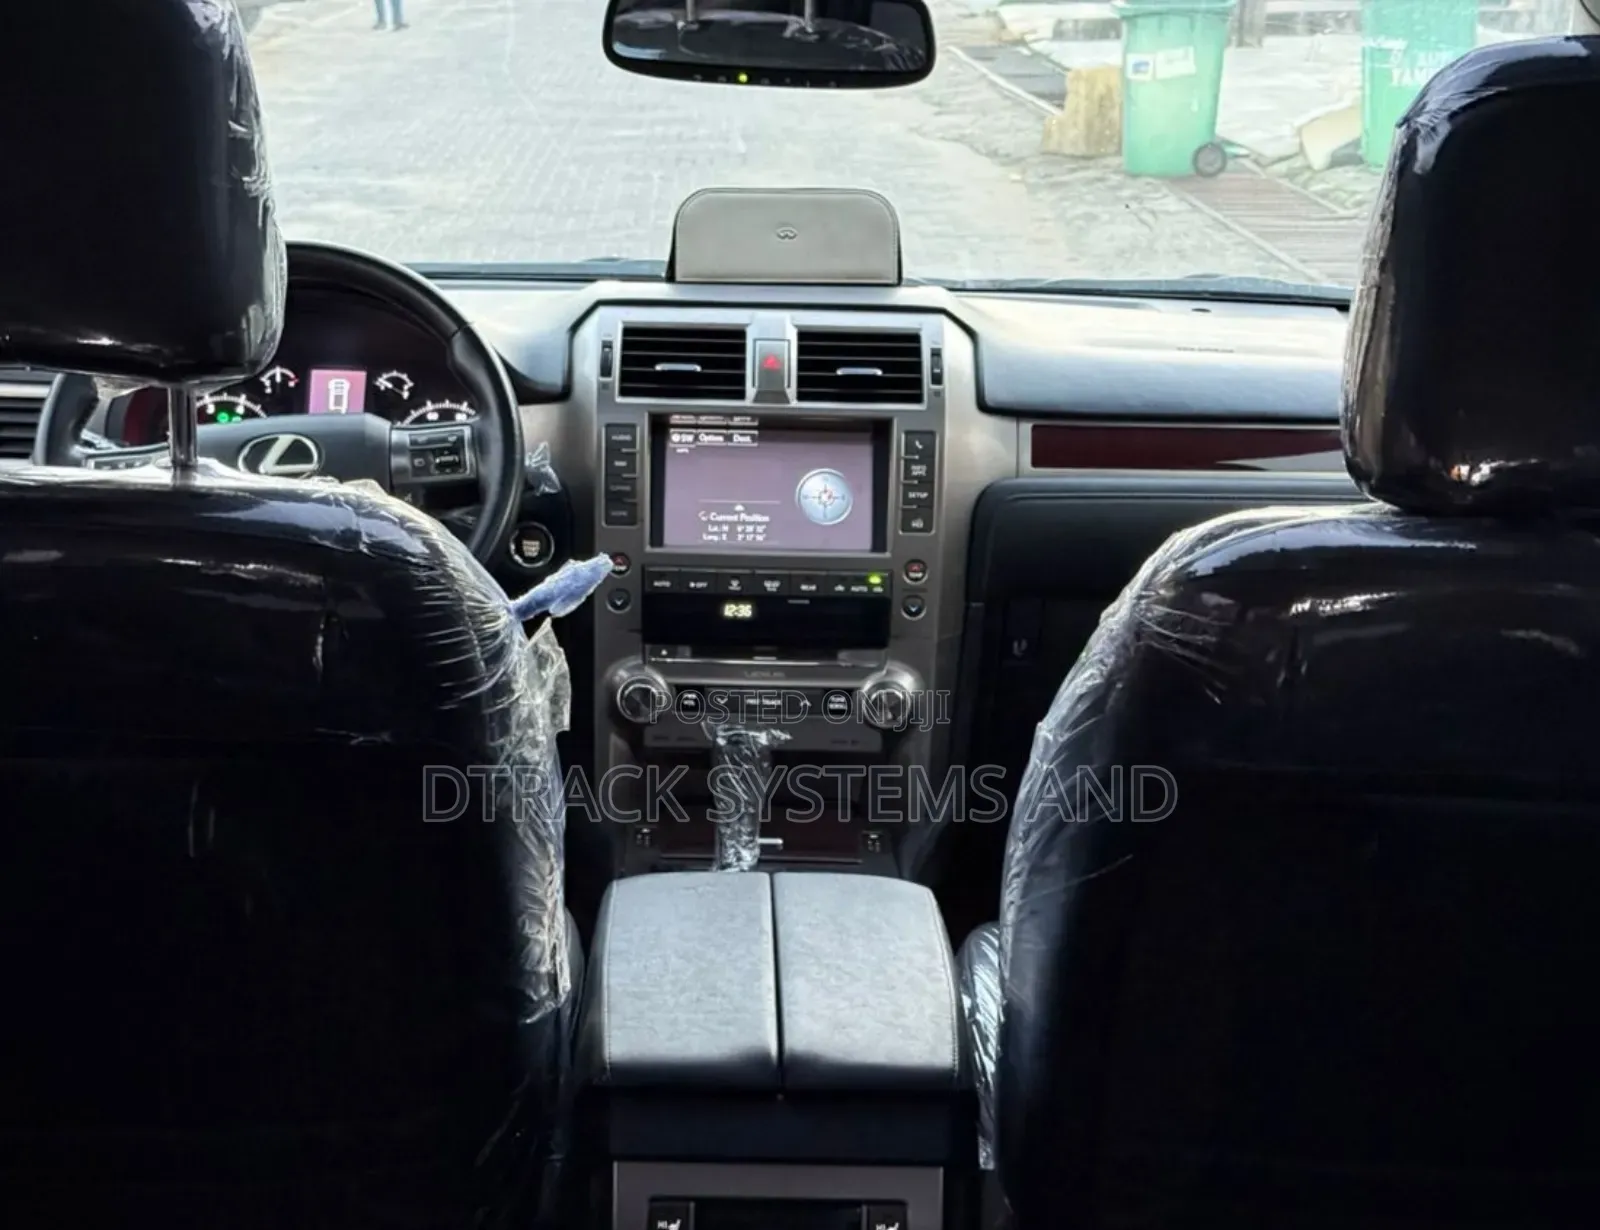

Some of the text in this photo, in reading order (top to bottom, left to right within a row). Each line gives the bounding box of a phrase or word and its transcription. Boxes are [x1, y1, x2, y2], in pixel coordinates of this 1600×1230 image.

[908, 491, 929, 499] SETUP
[709, 511, 771, 522] Current Position
